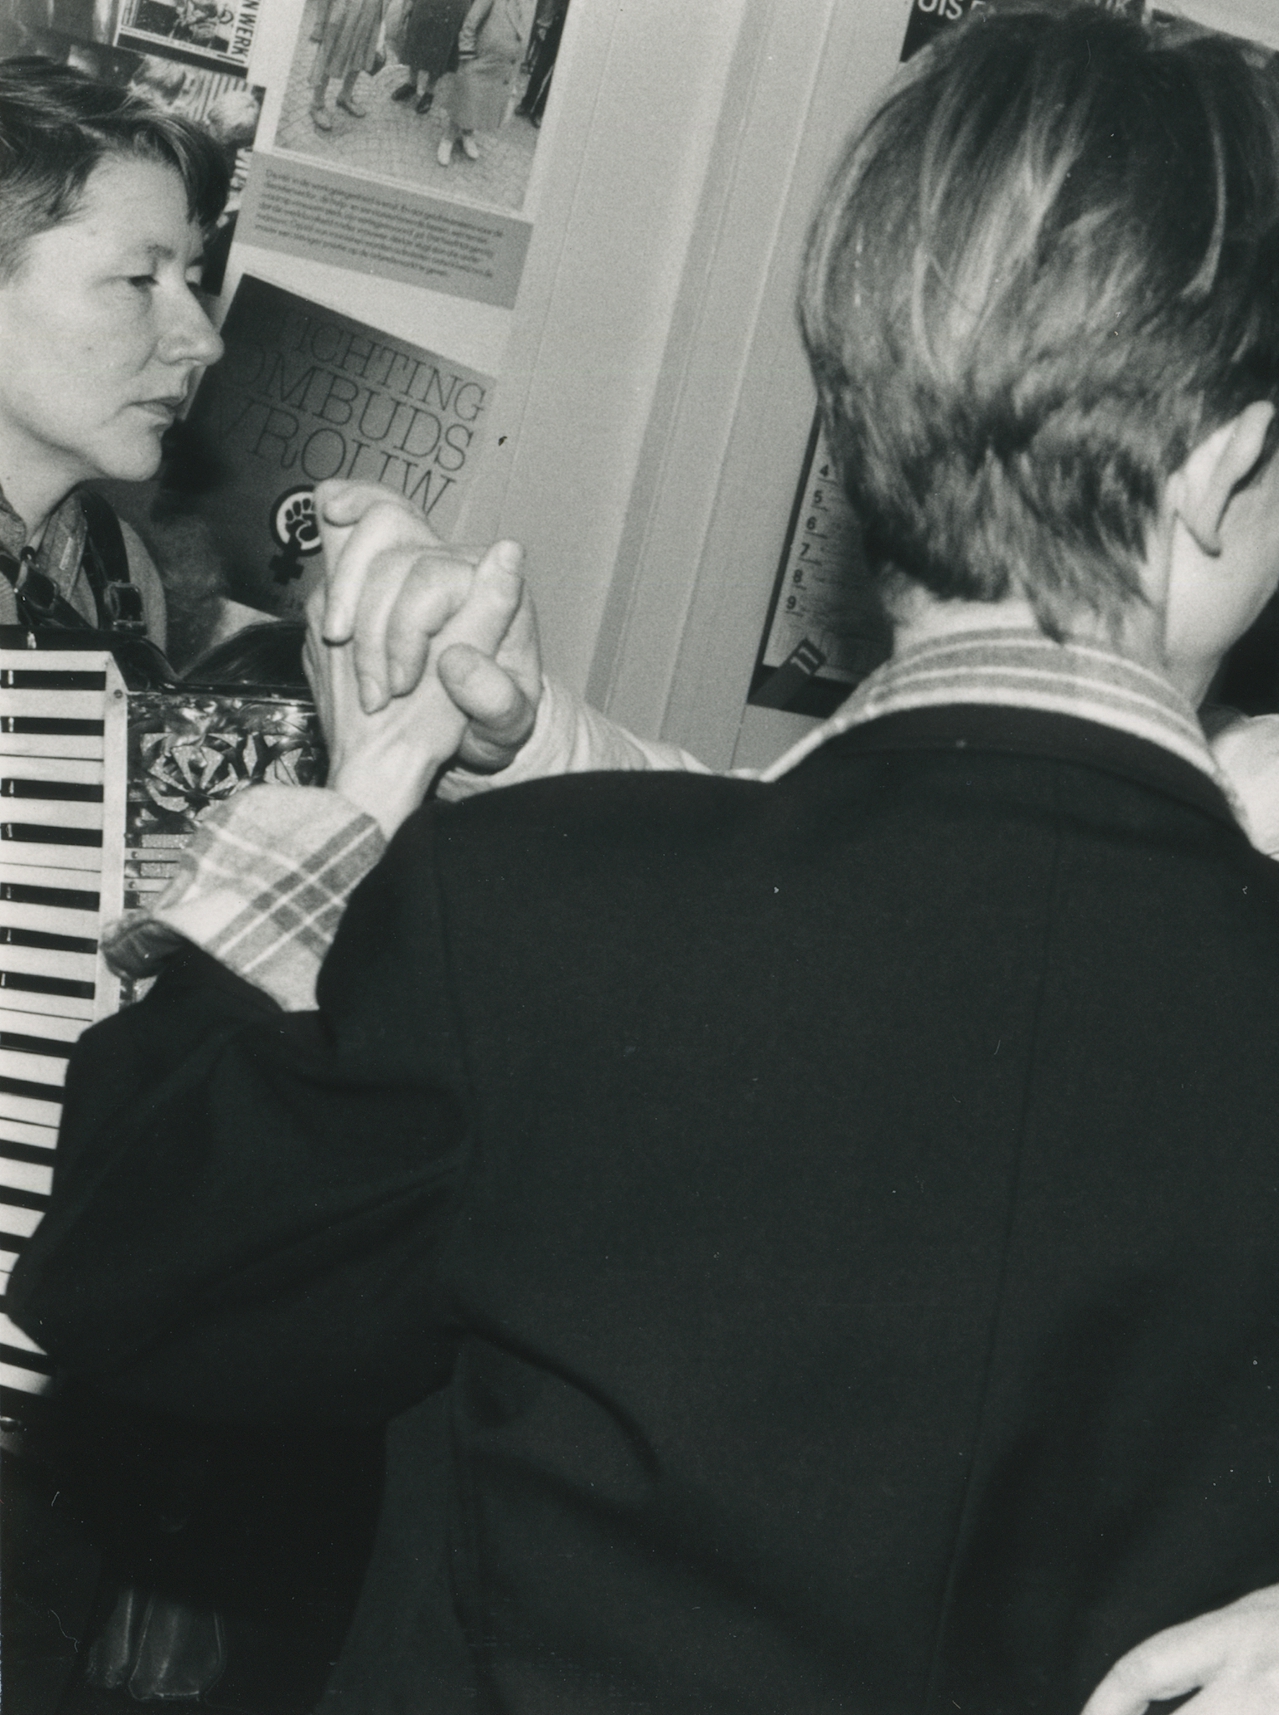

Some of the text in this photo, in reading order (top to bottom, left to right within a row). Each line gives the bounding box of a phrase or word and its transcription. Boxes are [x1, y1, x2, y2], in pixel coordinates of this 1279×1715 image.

[231, 13, 258, 59] WERK
[285, 313, 487, 423] ICHTING
[819, 464, 830, 477] 4
[813, 490, 823, 504] 5
[806, 516, 817, 531] 6
[800, 543, 811, 556] 7
[793, 569, 803, 583] 8
[786, 596, 797, 610] 9
